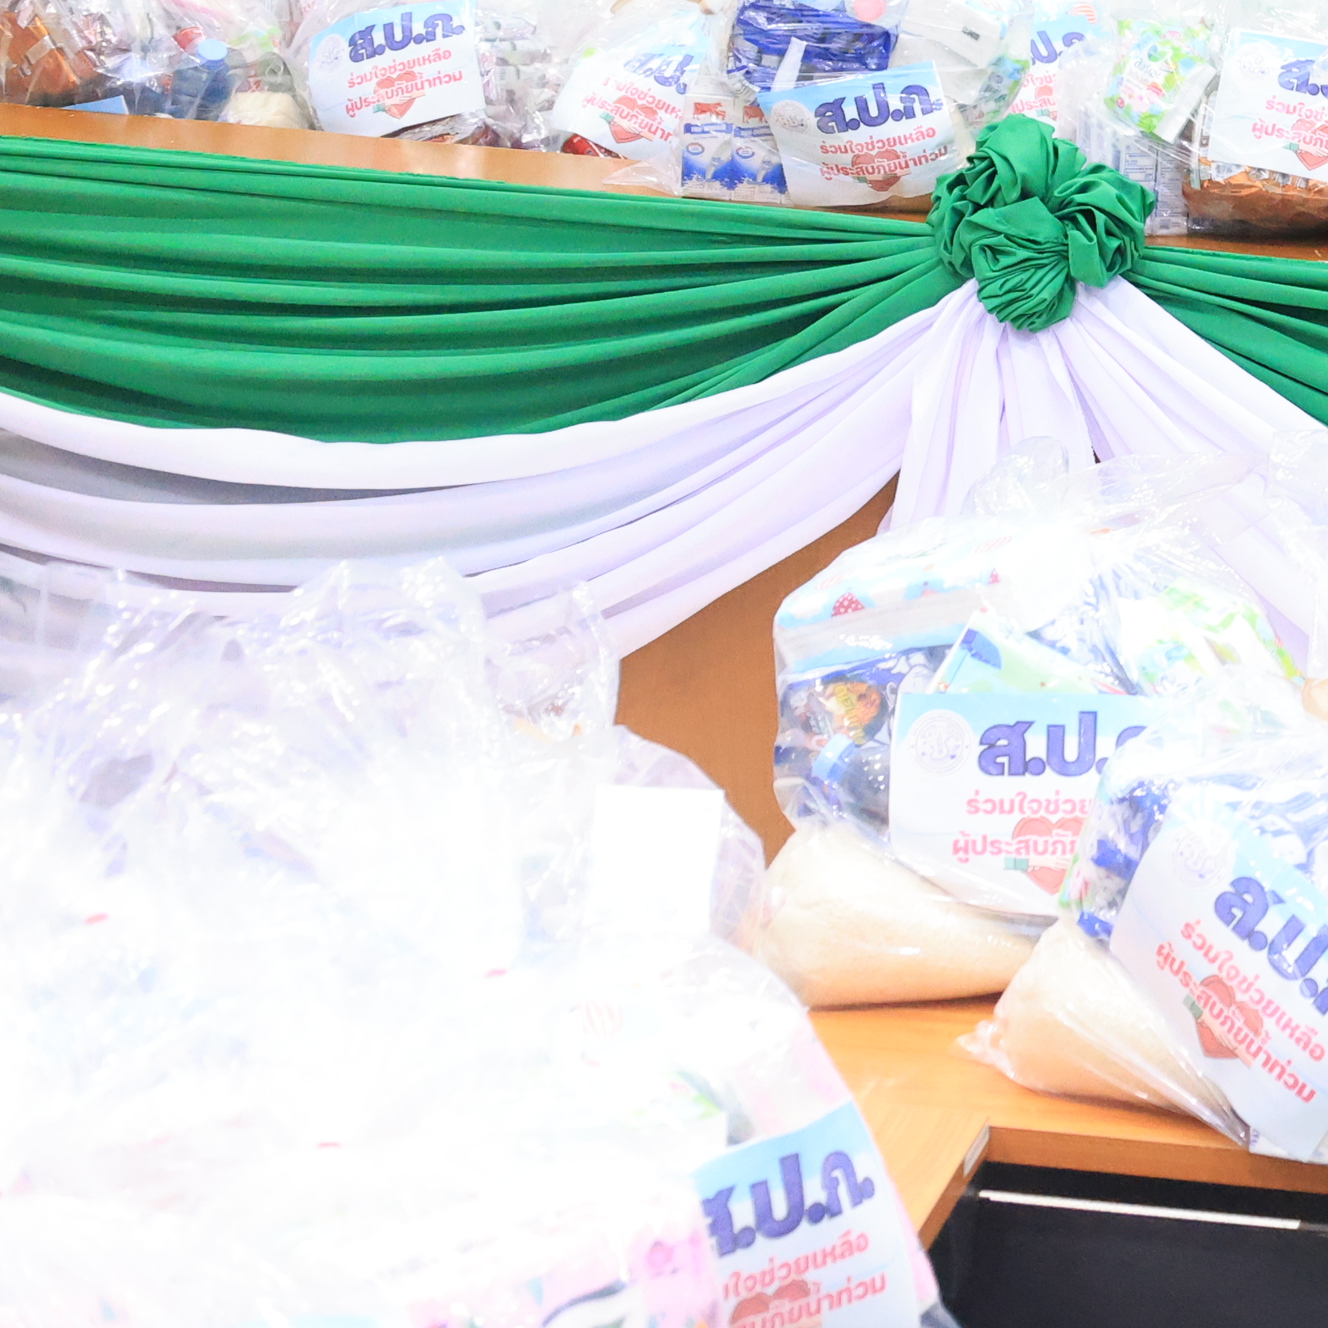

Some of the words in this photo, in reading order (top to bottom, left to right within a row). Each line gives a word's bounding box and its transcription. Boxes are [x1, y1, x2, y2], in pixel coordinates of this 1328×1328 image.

[348, 8, 465, 63] ส.ป.ก.
[345, 69, 464, 121] ผู้ประสบภัยน้ำท่วม
[347, 48, 453, 90] ร่วมใจช่วยเหลือ
[814, 83, 942, 136] ส.ป.ก.
[820, 125, 936, 156] ร่วมใจช่วยเหลือ
[820, 145, 948, 181] ผู้ประสบภัยน้ำท่วม
[966, 789, 1089, 815] ร่วมใจช่วย
[1180, 921, 1326, 1062] ร่วมใจช่วยเหลือ
[1155, 941, 1317, 1104] ผู้ประสบภัยน้ำท่วม
